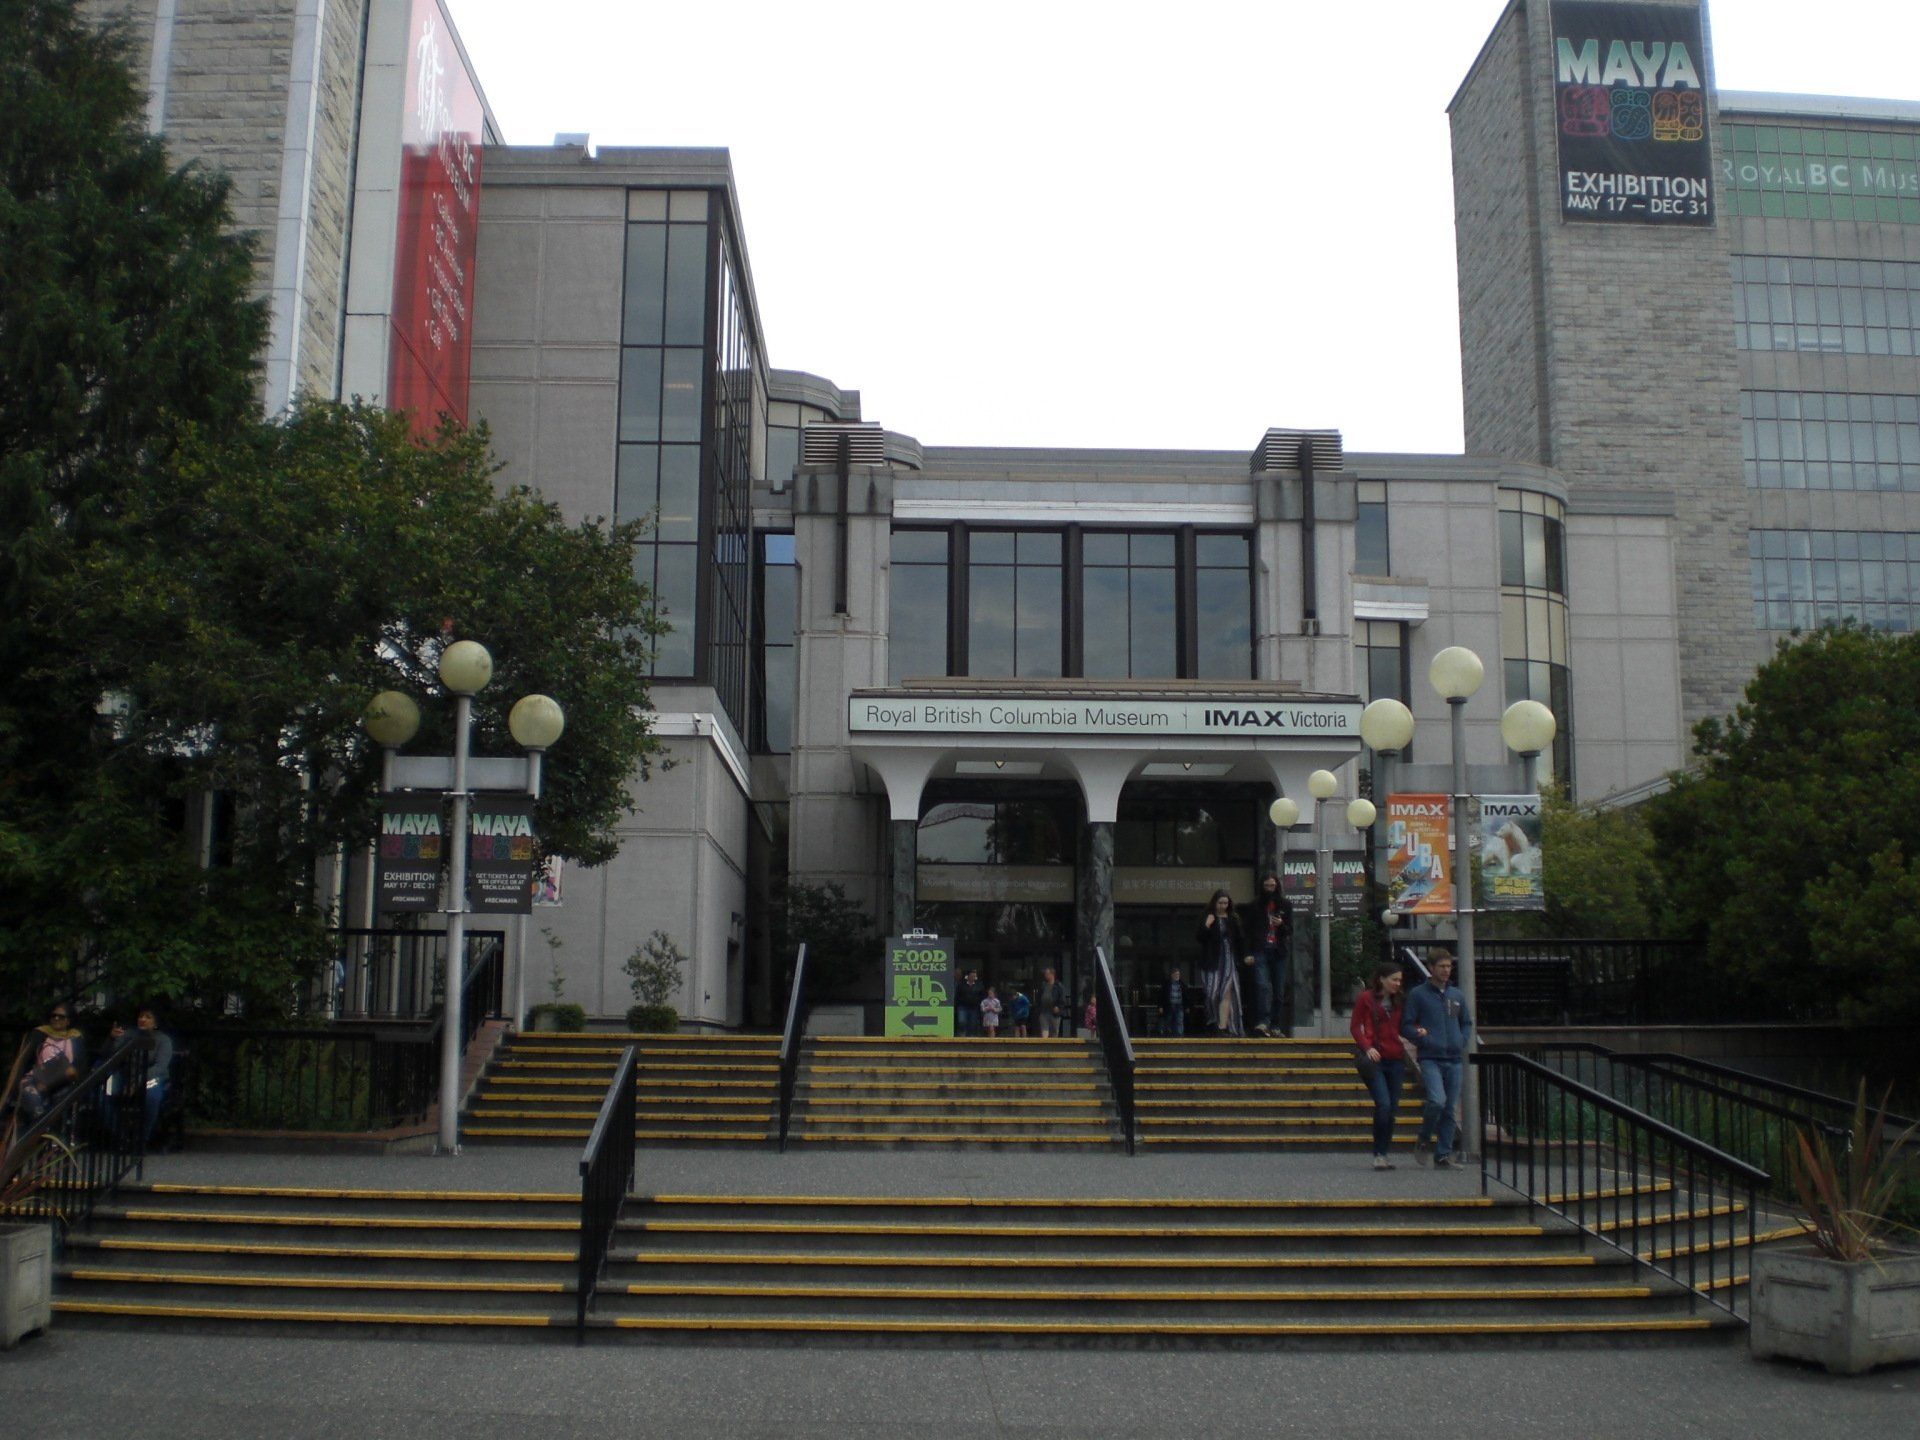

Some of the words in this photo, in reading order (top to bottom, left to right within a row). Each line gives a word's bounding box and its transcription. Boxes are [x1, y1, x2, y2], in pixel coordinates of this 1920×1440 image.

[1557, 38, 1700, 88] MAYA
[1809, 163, 1849, 187] BC
[1567, 171, 1707, 198] EXHIBITION
[1567, 194, 1600, 211] MAY
[1607, 196, 1627, 211] 17
[1651, 198, 1683, 214] DEC
[1689, 200, 1707, 215] 31
[866, 705, 916, 727] Royal
[924, 706, 982, 724] British
[989, 706, 1077, 725] Columbia
[1085, 708, 1169, 726] Museum
[1204, 709, 1285, 727] IMAX
[1291, 711, 1347, 728] Victoria
[1391, 804, 1444, 816] IMAX
[1485, 805, 1537, 816] IMAX
[383, 814, 440, 835] MAYA
[473, 814, 532, 836] MAYA
[1284, 862, 1316, 875] MAYA
[1333, 861, 1365, 874] MAYA
[384, 872, 435, 881] EXHIBITION
[893, 949, 947, 963] FOOD
[893, 962, 947, 972] TRUCKS
